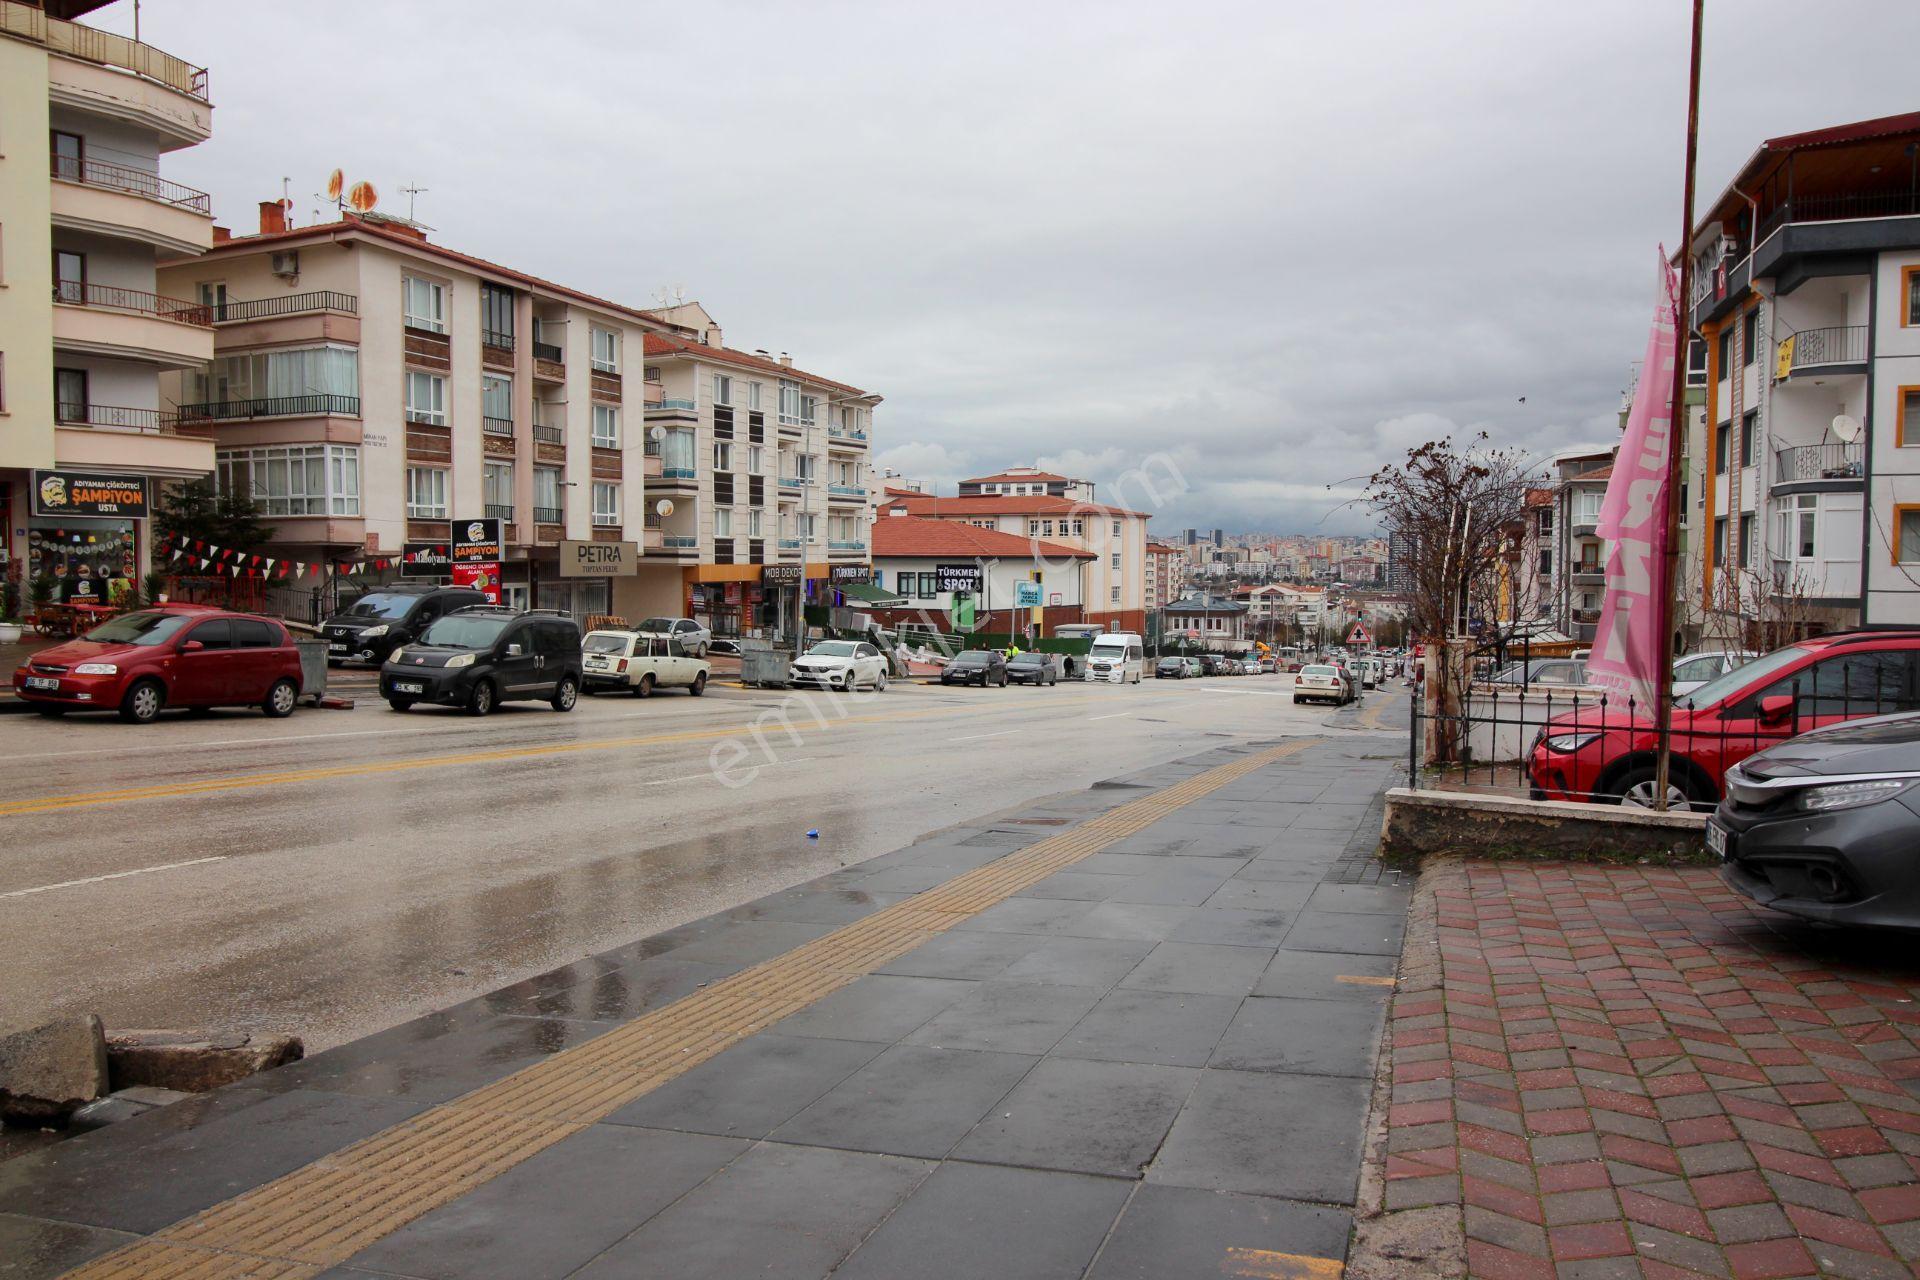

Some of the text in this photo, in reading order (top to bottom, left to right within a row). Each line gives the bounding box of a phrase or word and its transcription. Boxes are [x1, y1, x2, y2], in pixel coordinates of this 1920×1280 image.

[74, 480, 106, 488] ADIYAMAN
[72, 488, 142, 506] ŞAMPİYON
[98, 503, 118, 512] USTA
[577, 545, 622, 563] PETRA
[857, 567, 869, 577] SPOT
[937, 566, 980, 577] TÜRKMEN
[943, 578, 974, 591] SPOT
